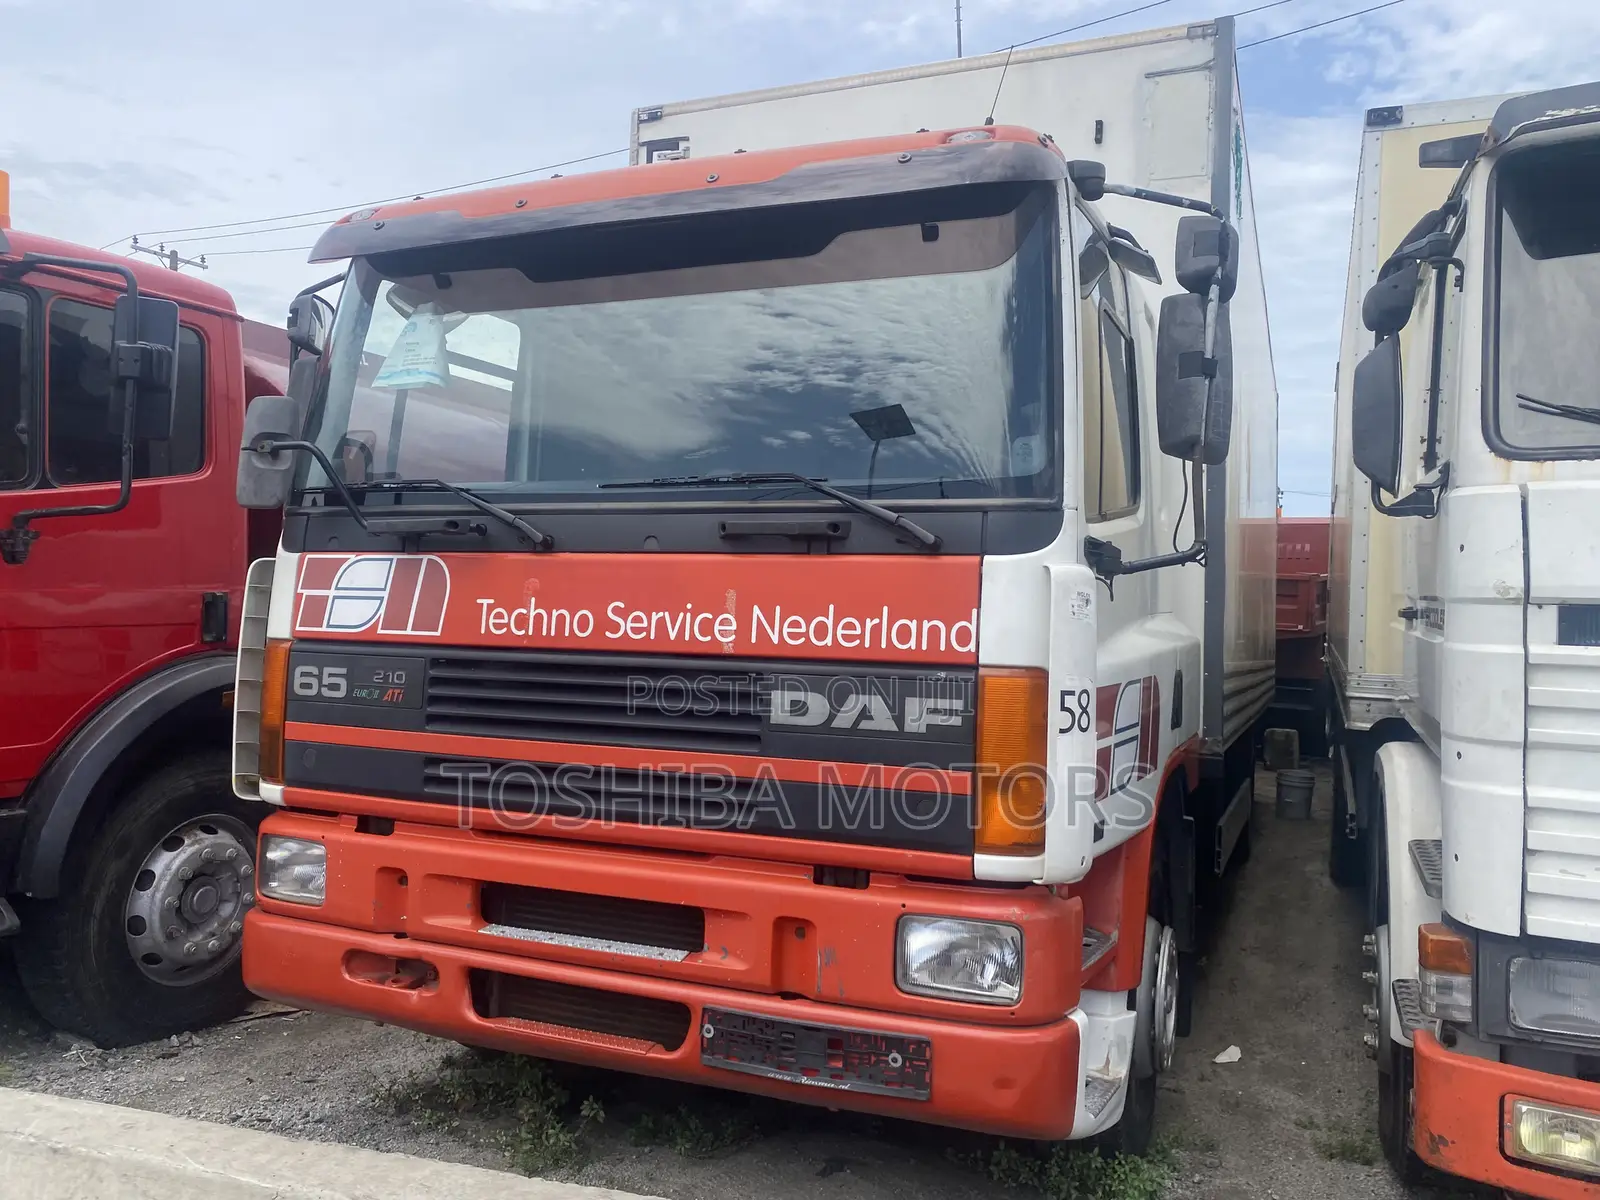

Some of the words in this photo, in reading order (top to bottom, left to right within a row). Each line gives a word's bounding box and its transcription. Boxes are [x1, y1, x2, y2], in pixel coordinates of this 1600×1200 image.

[476, 597, 594, 637] Techno
[605, 601, 737, 643] Service
[751, 604, 978, 653] Nederland
[293, 665, 348, 698] 65
[373, 669, 407, 684] 210
[769, 690, 965, 734] DAF
[1058, 688, 1091, 734] 58
